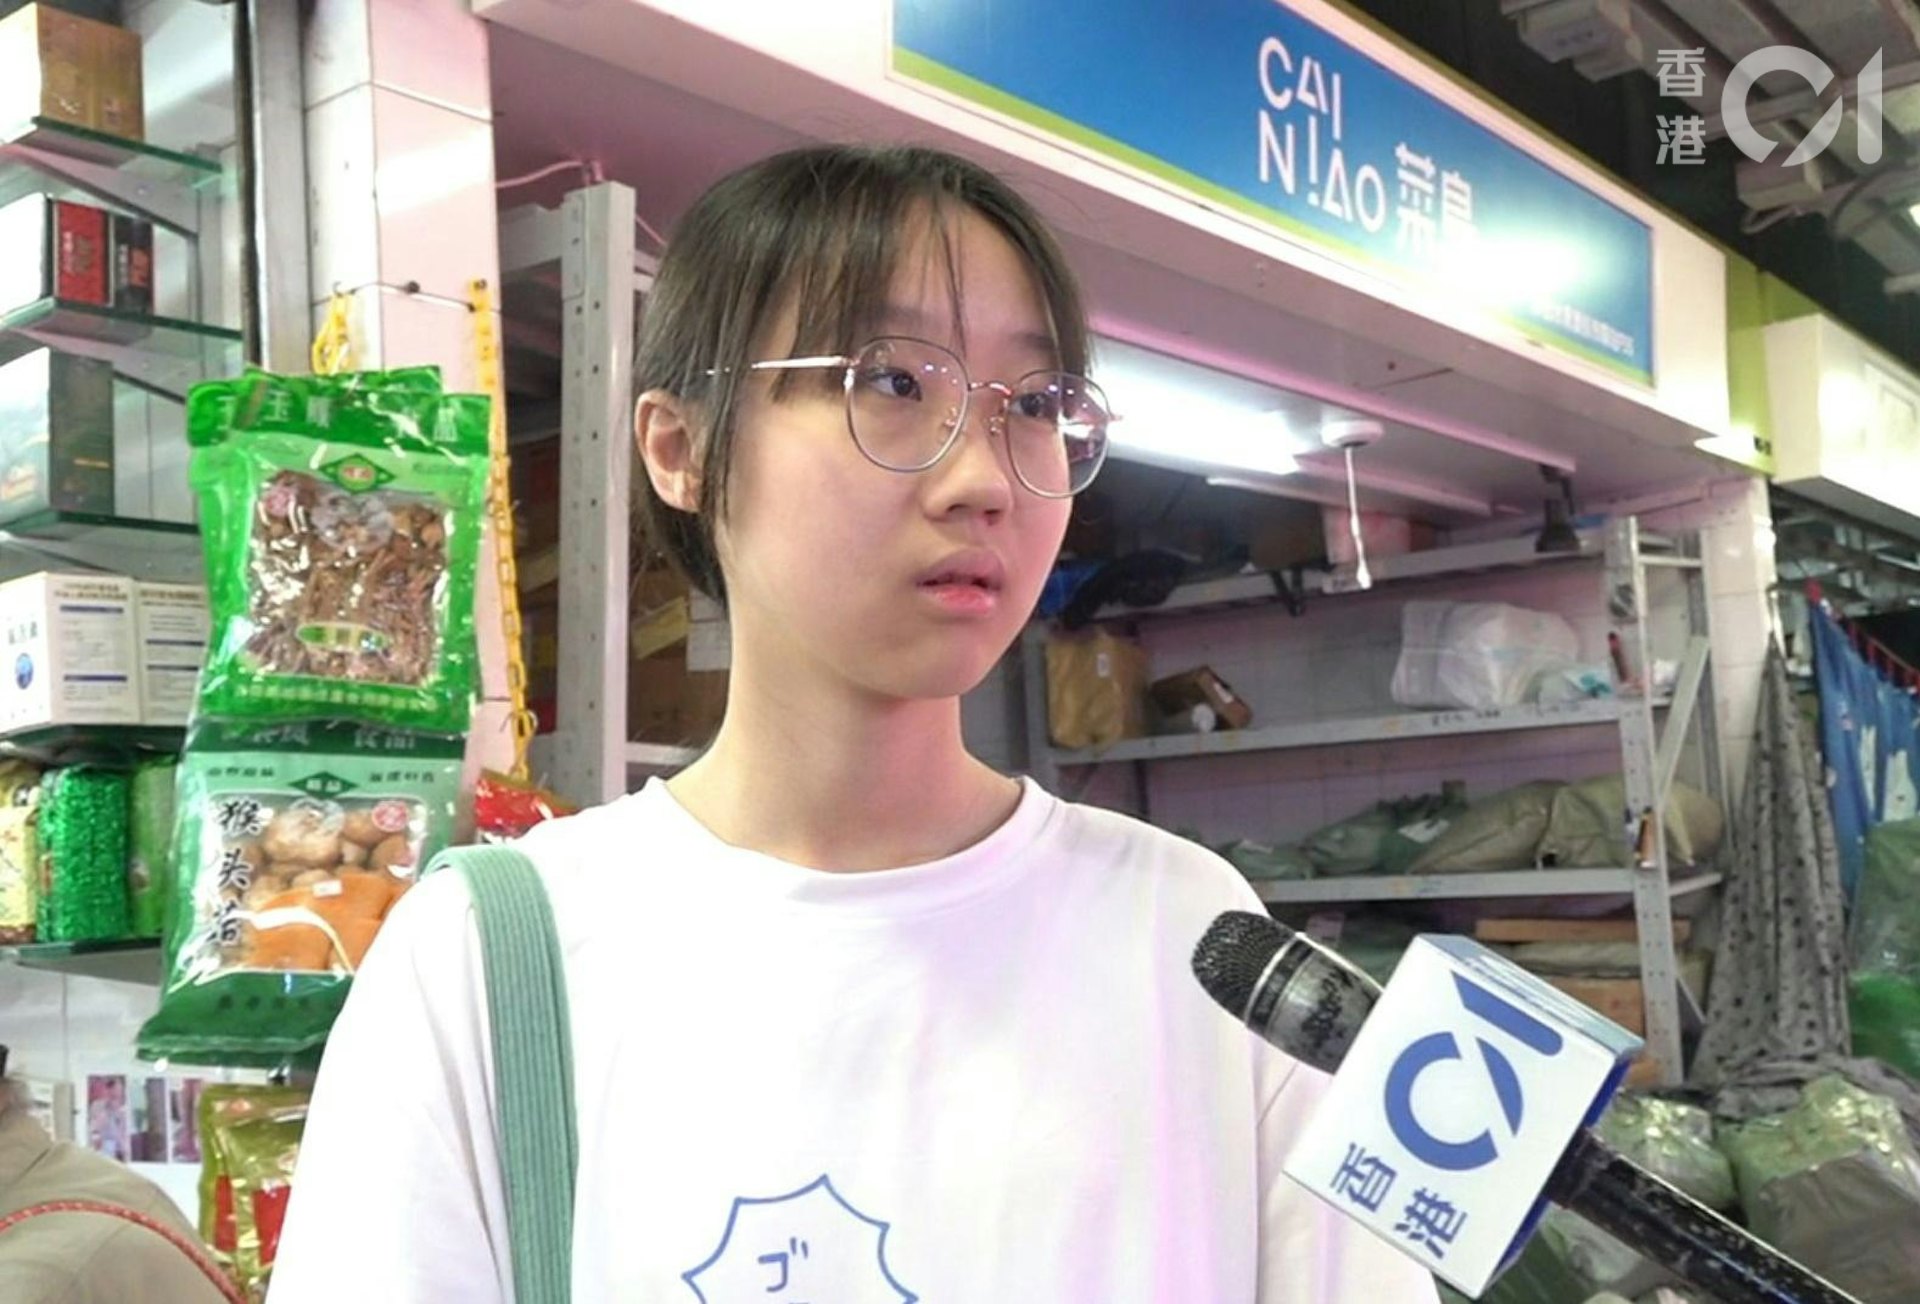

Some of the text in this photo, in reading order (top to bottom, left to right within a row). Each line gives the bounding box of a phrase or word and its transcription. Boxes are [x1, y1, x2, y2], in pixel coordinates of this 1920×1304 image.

[1258, 36, 1342, 142] CAI
[1329, 969, 1564, 1260] 01 香港
